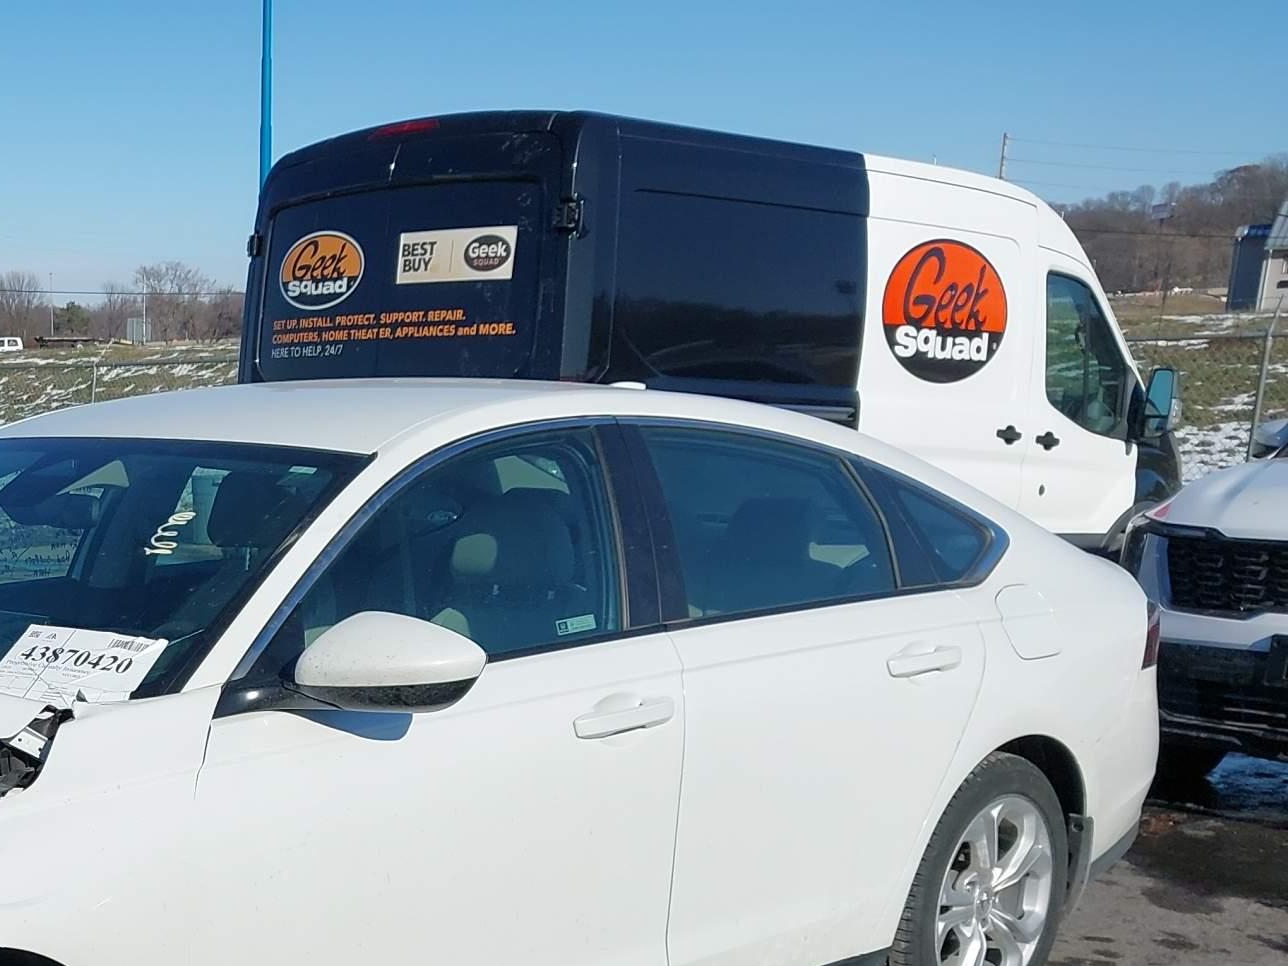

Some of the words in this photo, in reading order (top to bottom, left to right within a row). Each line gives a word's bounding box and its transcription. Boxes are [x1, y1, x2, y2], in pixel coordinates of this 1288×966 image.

[292, 239, 348, 280] Geek
[402, 241, 437, 257] BEST
[469, 241, 508, 258] Geek
[402, 257, 432, 273] BUY
[473, 257, 500, 266] SQUAD
[903, 246, 990, 331] Geek
[273, 319, 286, 330] SET
[286, 319, 298, 330] UP.
[335, 313, 377, 327] PROTECT.
[380, 311, 426, 324] SUPPORT.
[427, 309, 466, 321] REPAIR.
[272, 331, 321, 344] COMPUTERS,
[321, 330, 349, 342] HOME
[394, 324, 456, 338] APPLIANCES
[456, 324, 477, 336] and
[479, 322, 517, 336] MORE.
[894, 325, 990, 362] Squad
[271, 346, 289, 359] HERE
[290, 346, 302, 358] TO
[302, 345, 324, 358] HELP,
[325, 344, 344, 356] 24/7
[21, 645, 133, 675] 43870420
